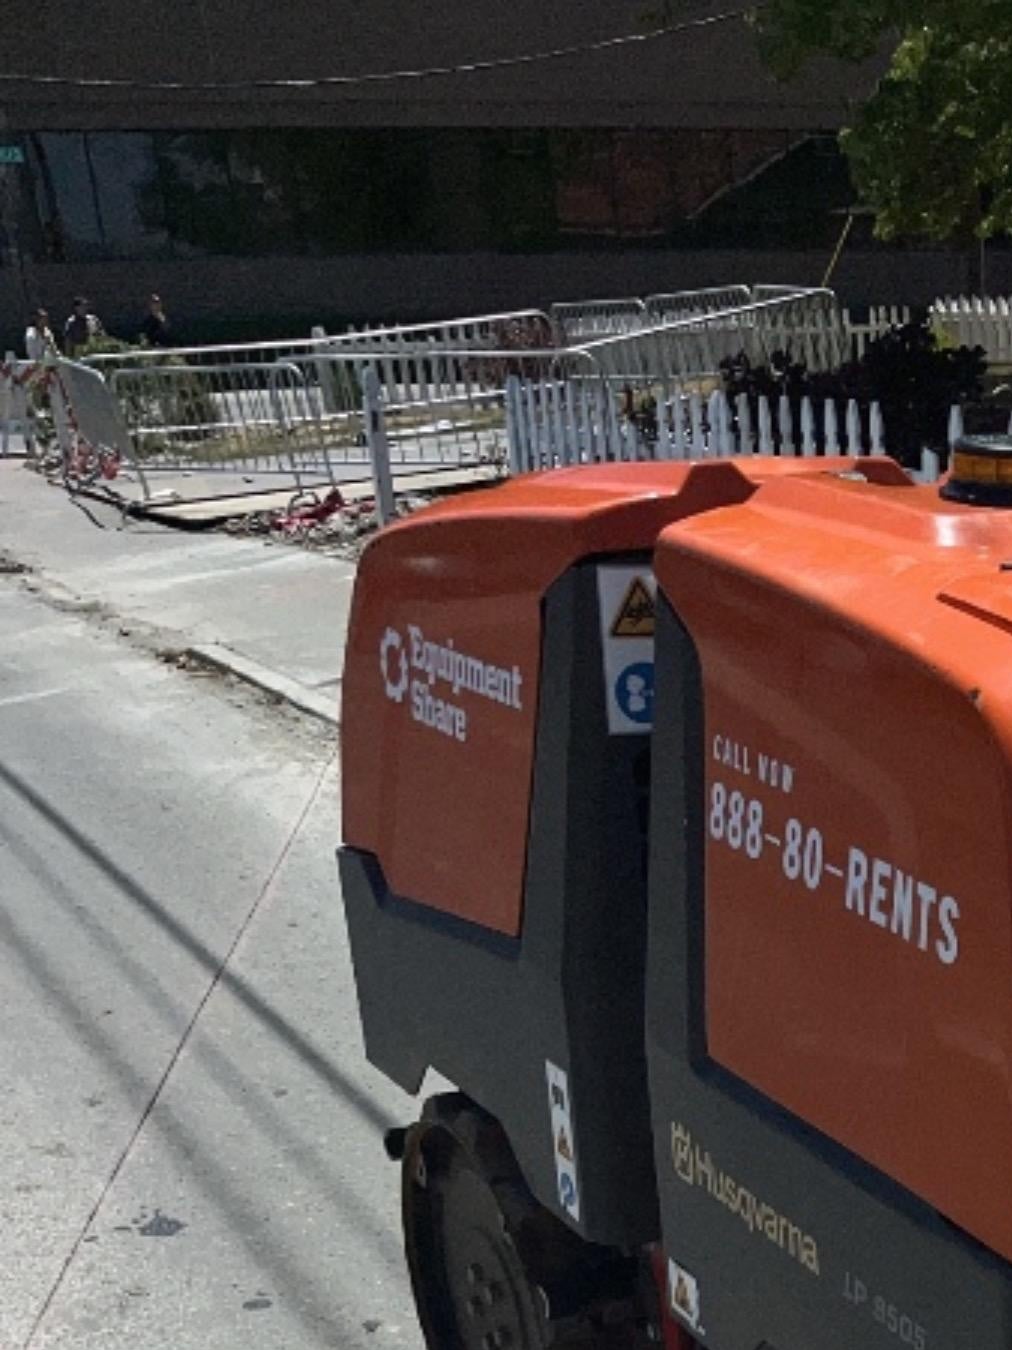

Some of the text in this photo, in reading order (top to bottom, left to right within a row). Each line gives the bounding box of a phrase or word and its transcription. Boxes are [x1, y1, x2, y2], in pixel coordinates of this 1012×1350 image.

[408, 624, 522, 711] Equipment
[412, 679, 466, 742] Share
[713, 734, 794, 793] CALL NOW
[709, 782, 960, 964] 888-80-RENTS
[697, 1143, 820, 1276] Husqvarna
[842, 1271, 868, 1305] LP
